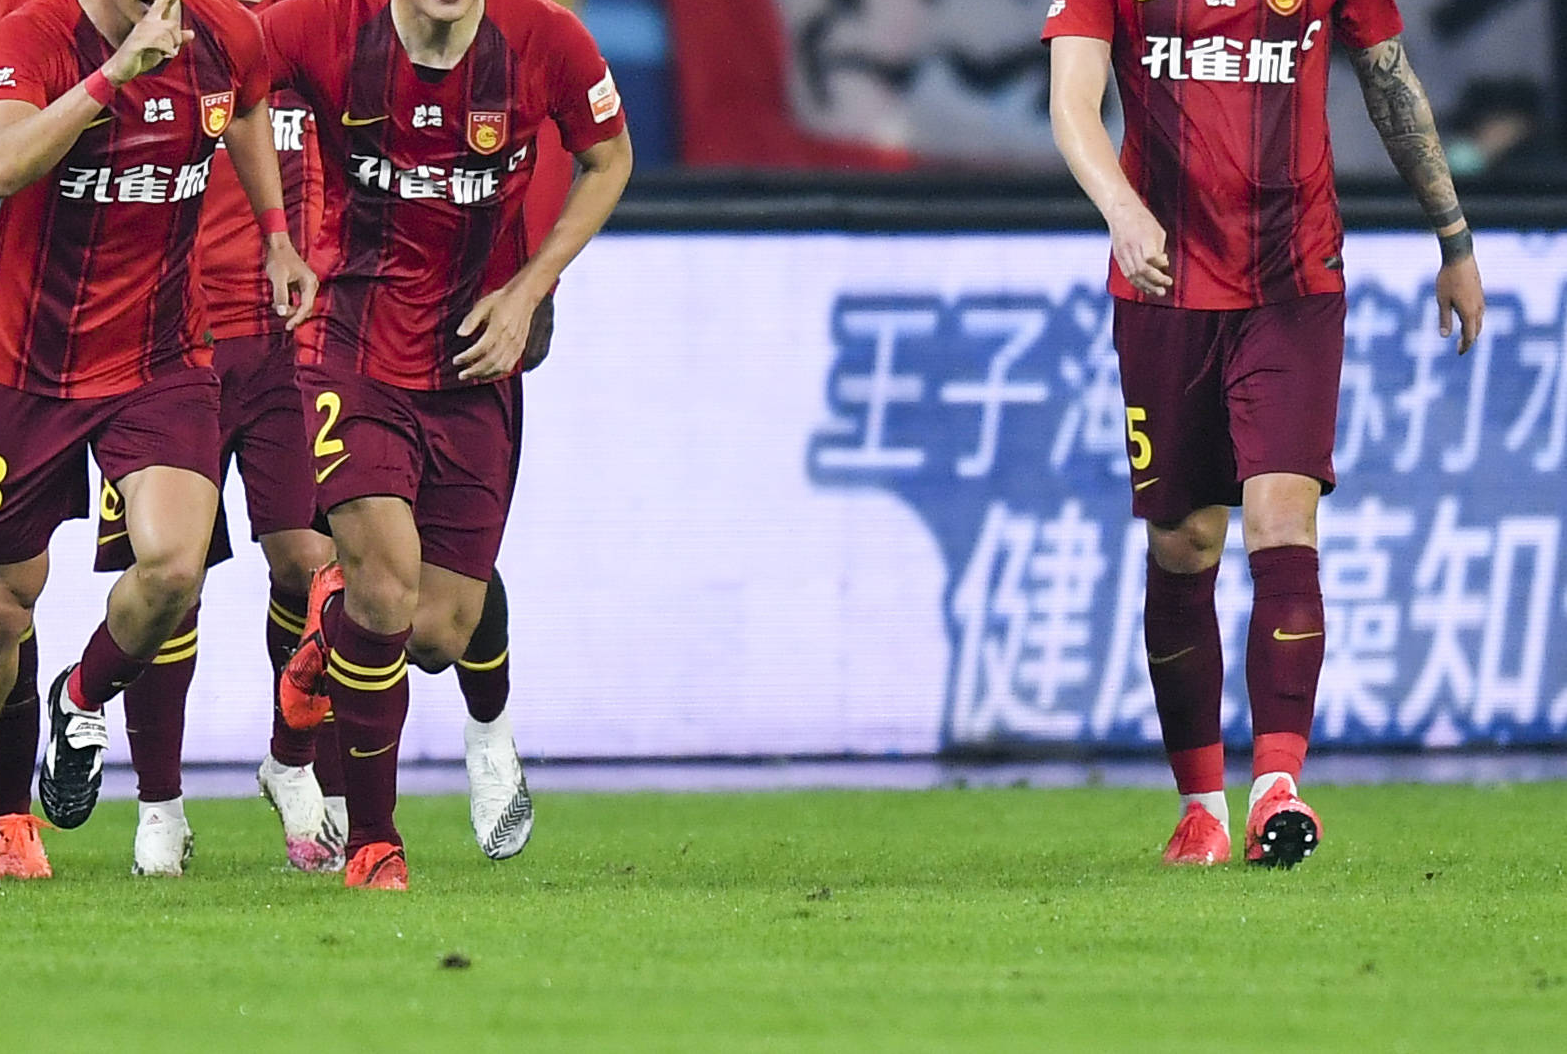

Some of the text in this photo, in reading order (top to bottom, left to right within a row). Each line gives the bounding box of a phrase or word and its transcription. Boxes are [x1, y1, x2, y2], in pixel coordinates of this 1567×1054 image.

[1141, 35, 1298, 84] 孔雀城
[59, 152, 216, 204] 孔雀城
[347, 153, 500, 205] 孔雀城
[313, 392, 344, 459] 2
